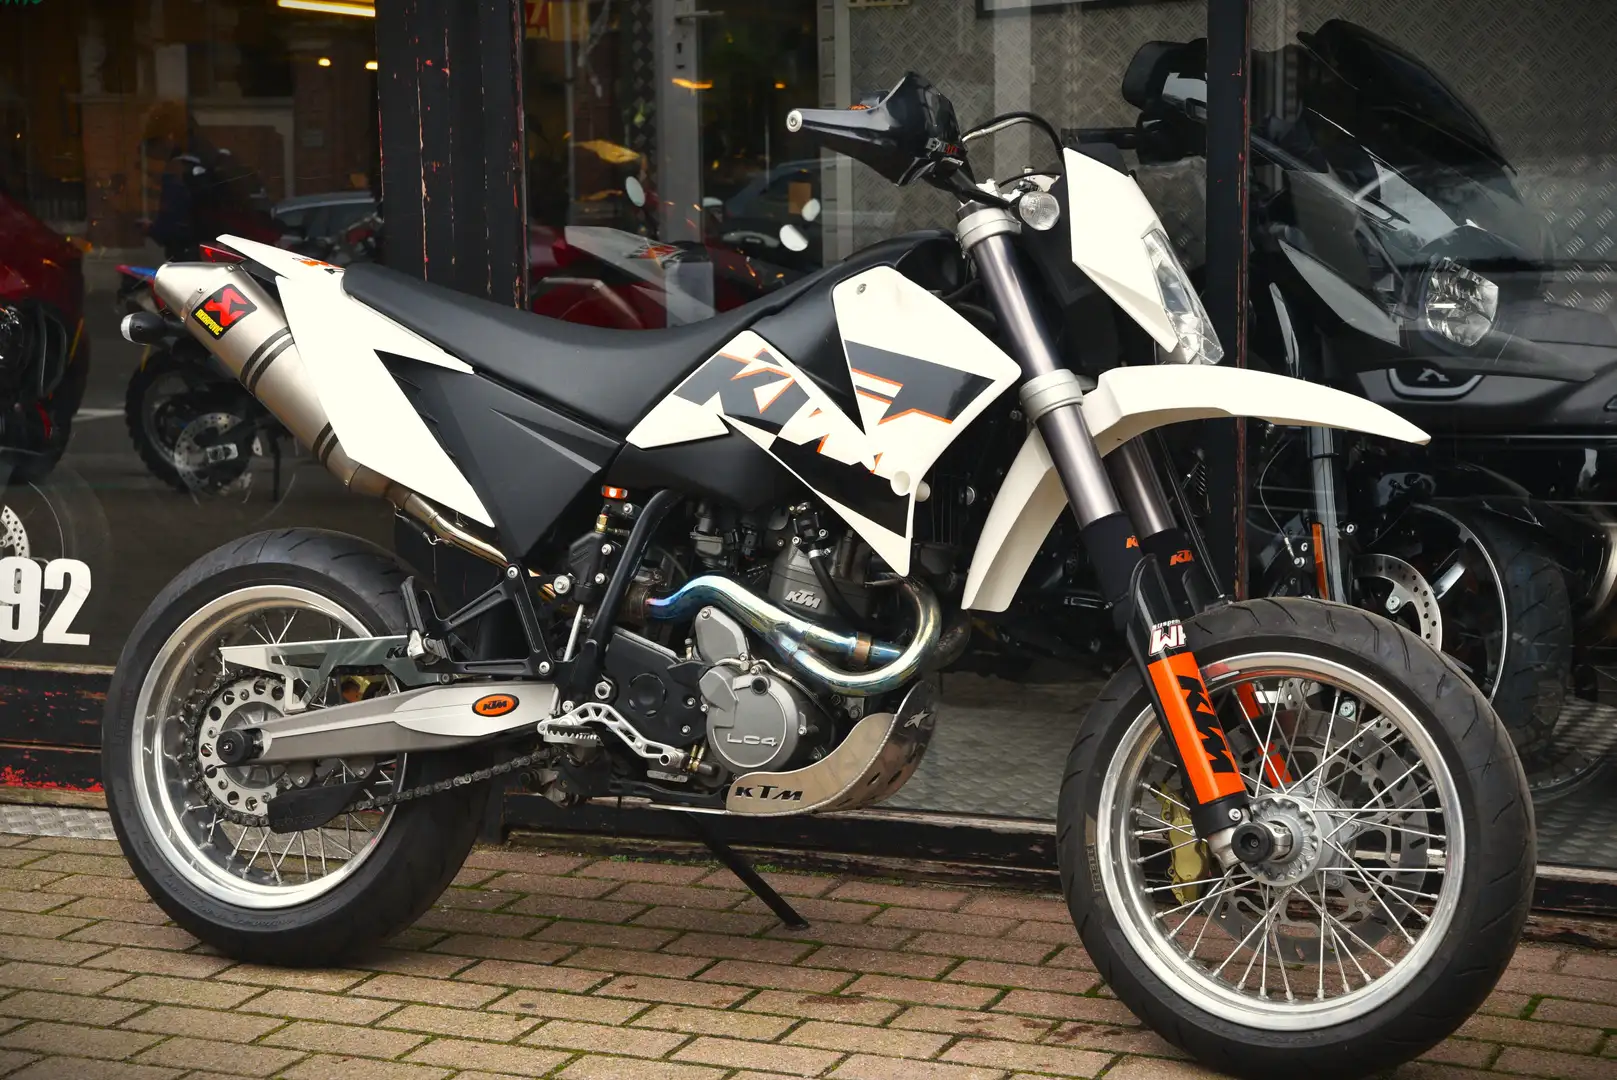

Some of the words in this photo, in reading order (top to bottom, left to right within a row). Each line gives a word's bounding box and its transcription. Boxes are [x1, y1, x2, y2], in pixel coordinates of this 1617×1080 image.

[1126, 535, 1139, 548] K
[785, 590, 821, 609] KTM
[483, 700, 508, 711] KTM
[1176, 675, 1236, 773] KTM
[727, 733, 778, 747] LC4
[735, 784, 803, 801] KTM
